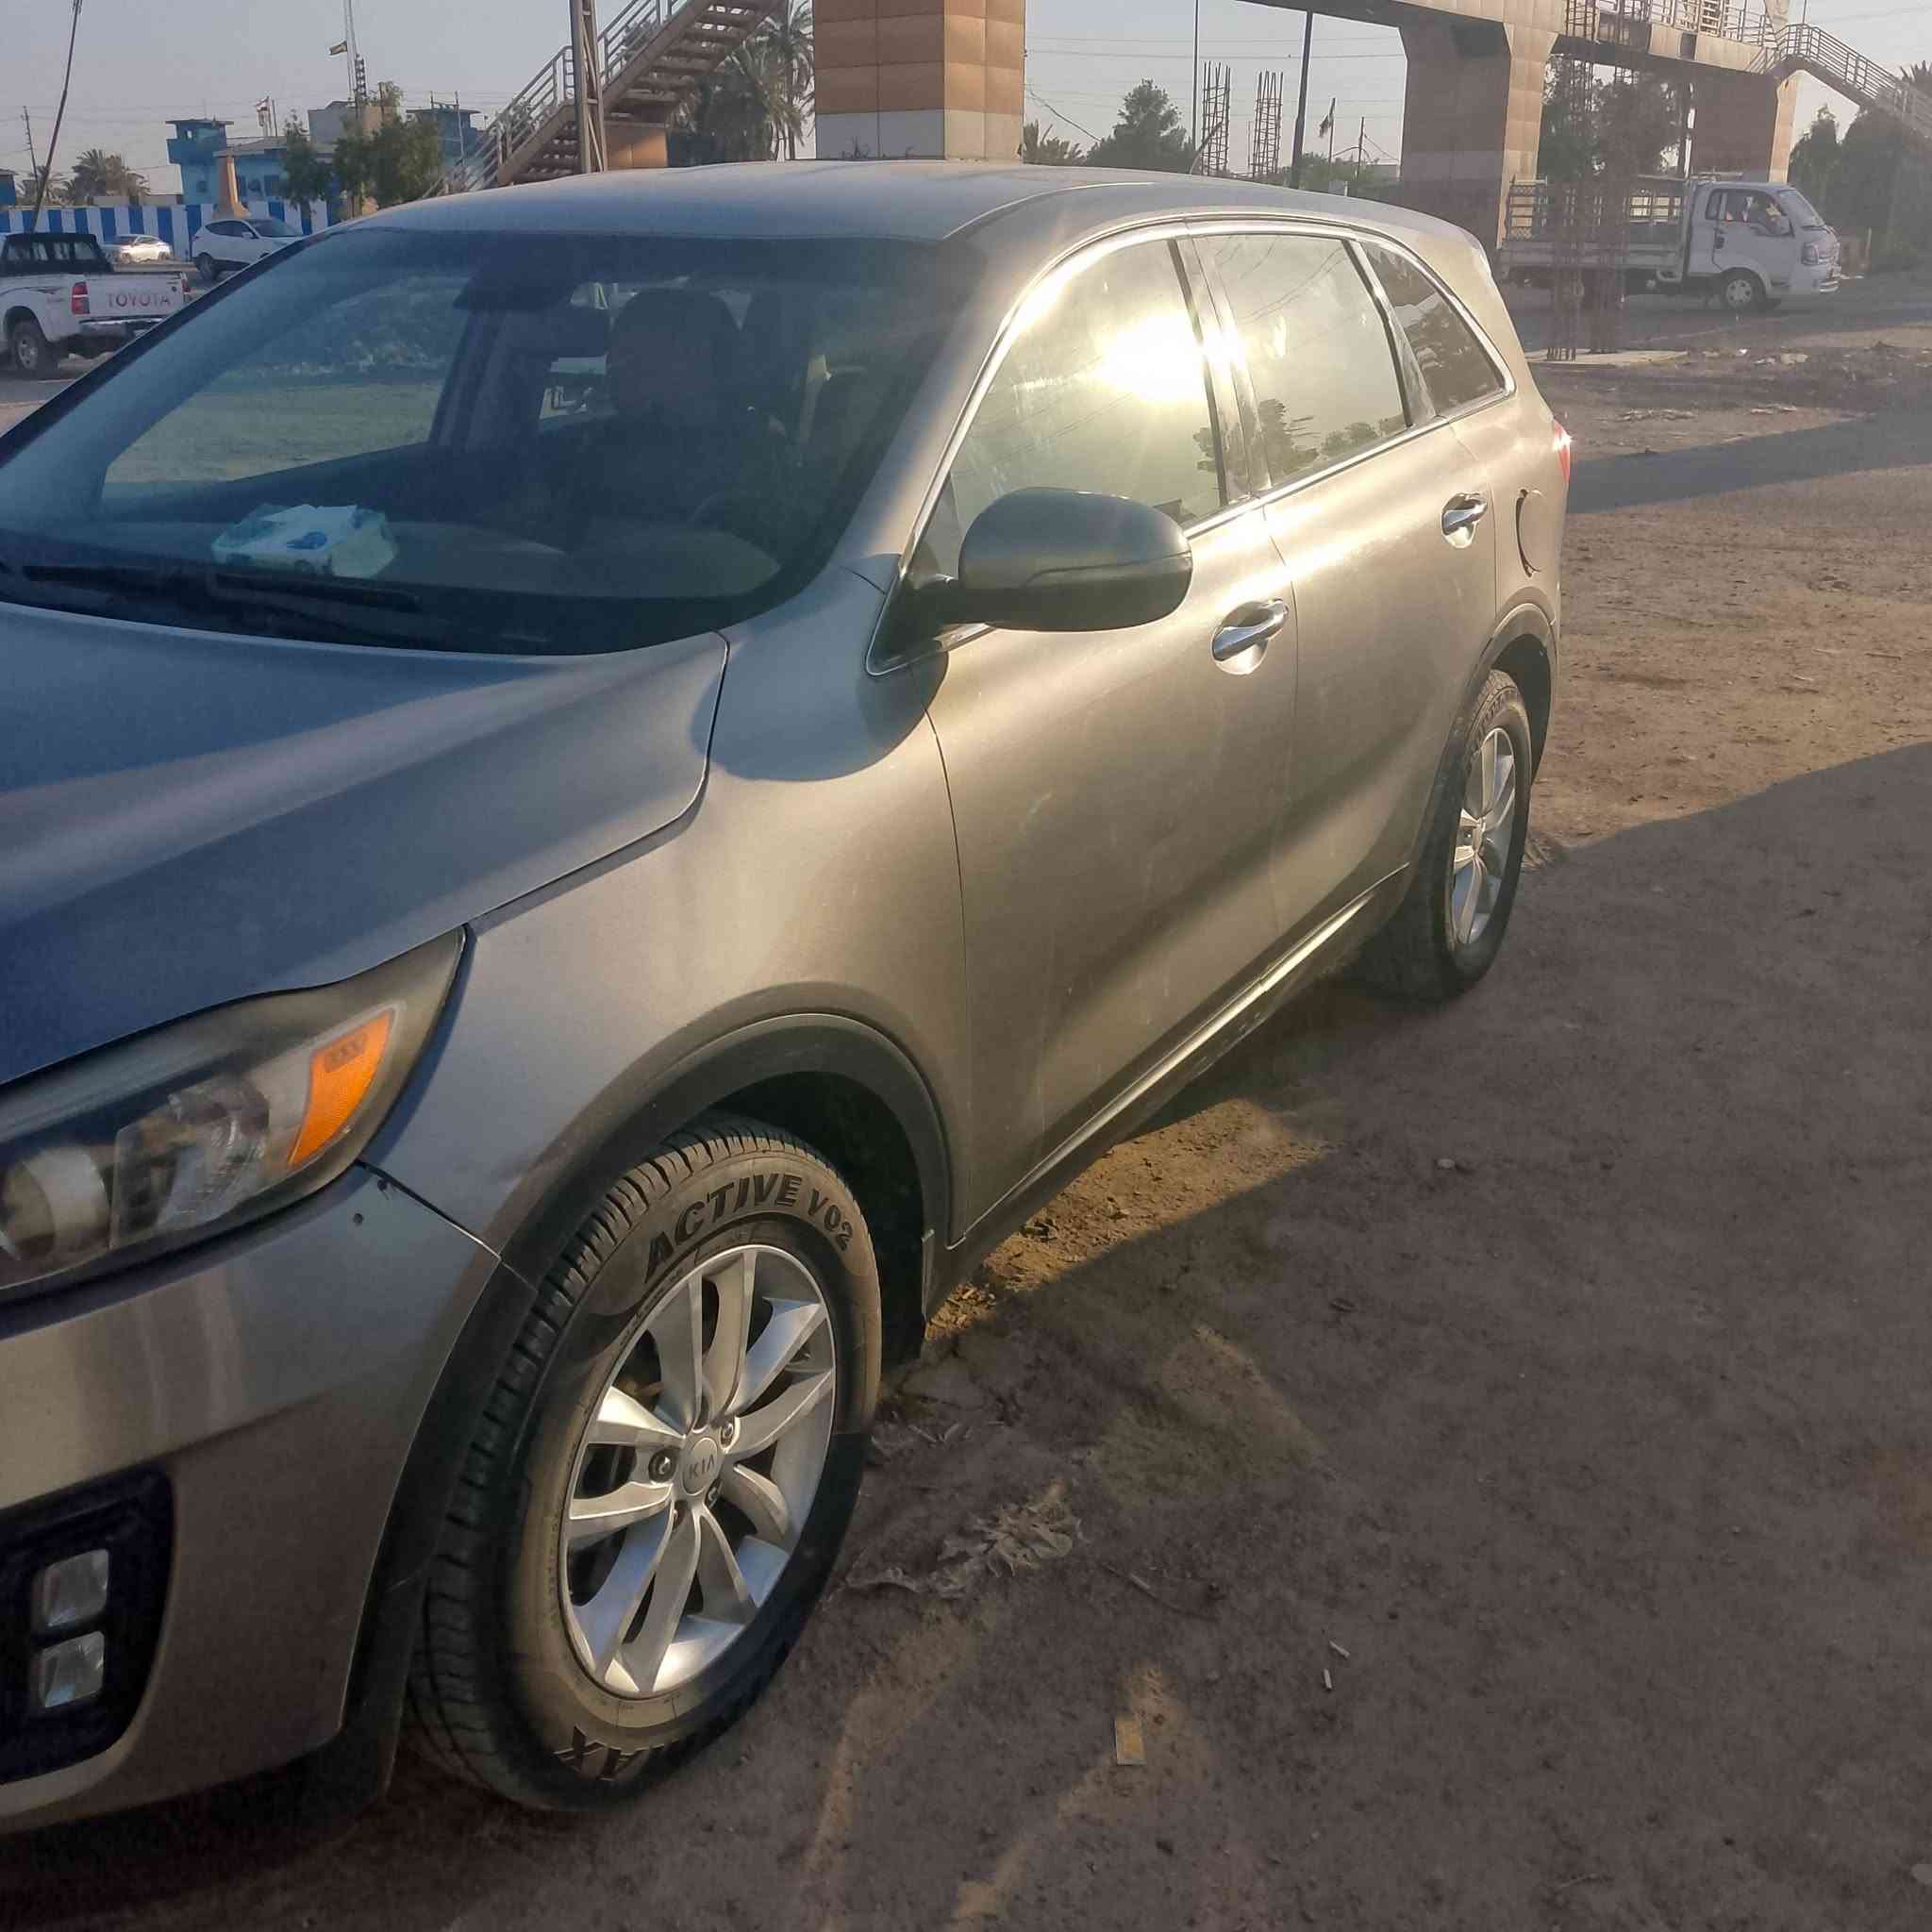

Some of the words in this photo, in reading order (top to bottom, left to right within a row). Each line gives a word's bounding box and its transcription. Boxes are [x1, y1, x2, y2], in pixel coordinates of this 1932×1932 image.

[106, 292, 172, 308] TOYOTA
[644, 1172, 803, 1284] ACTIVE
[689, 1454, 715, 1480] KIA
